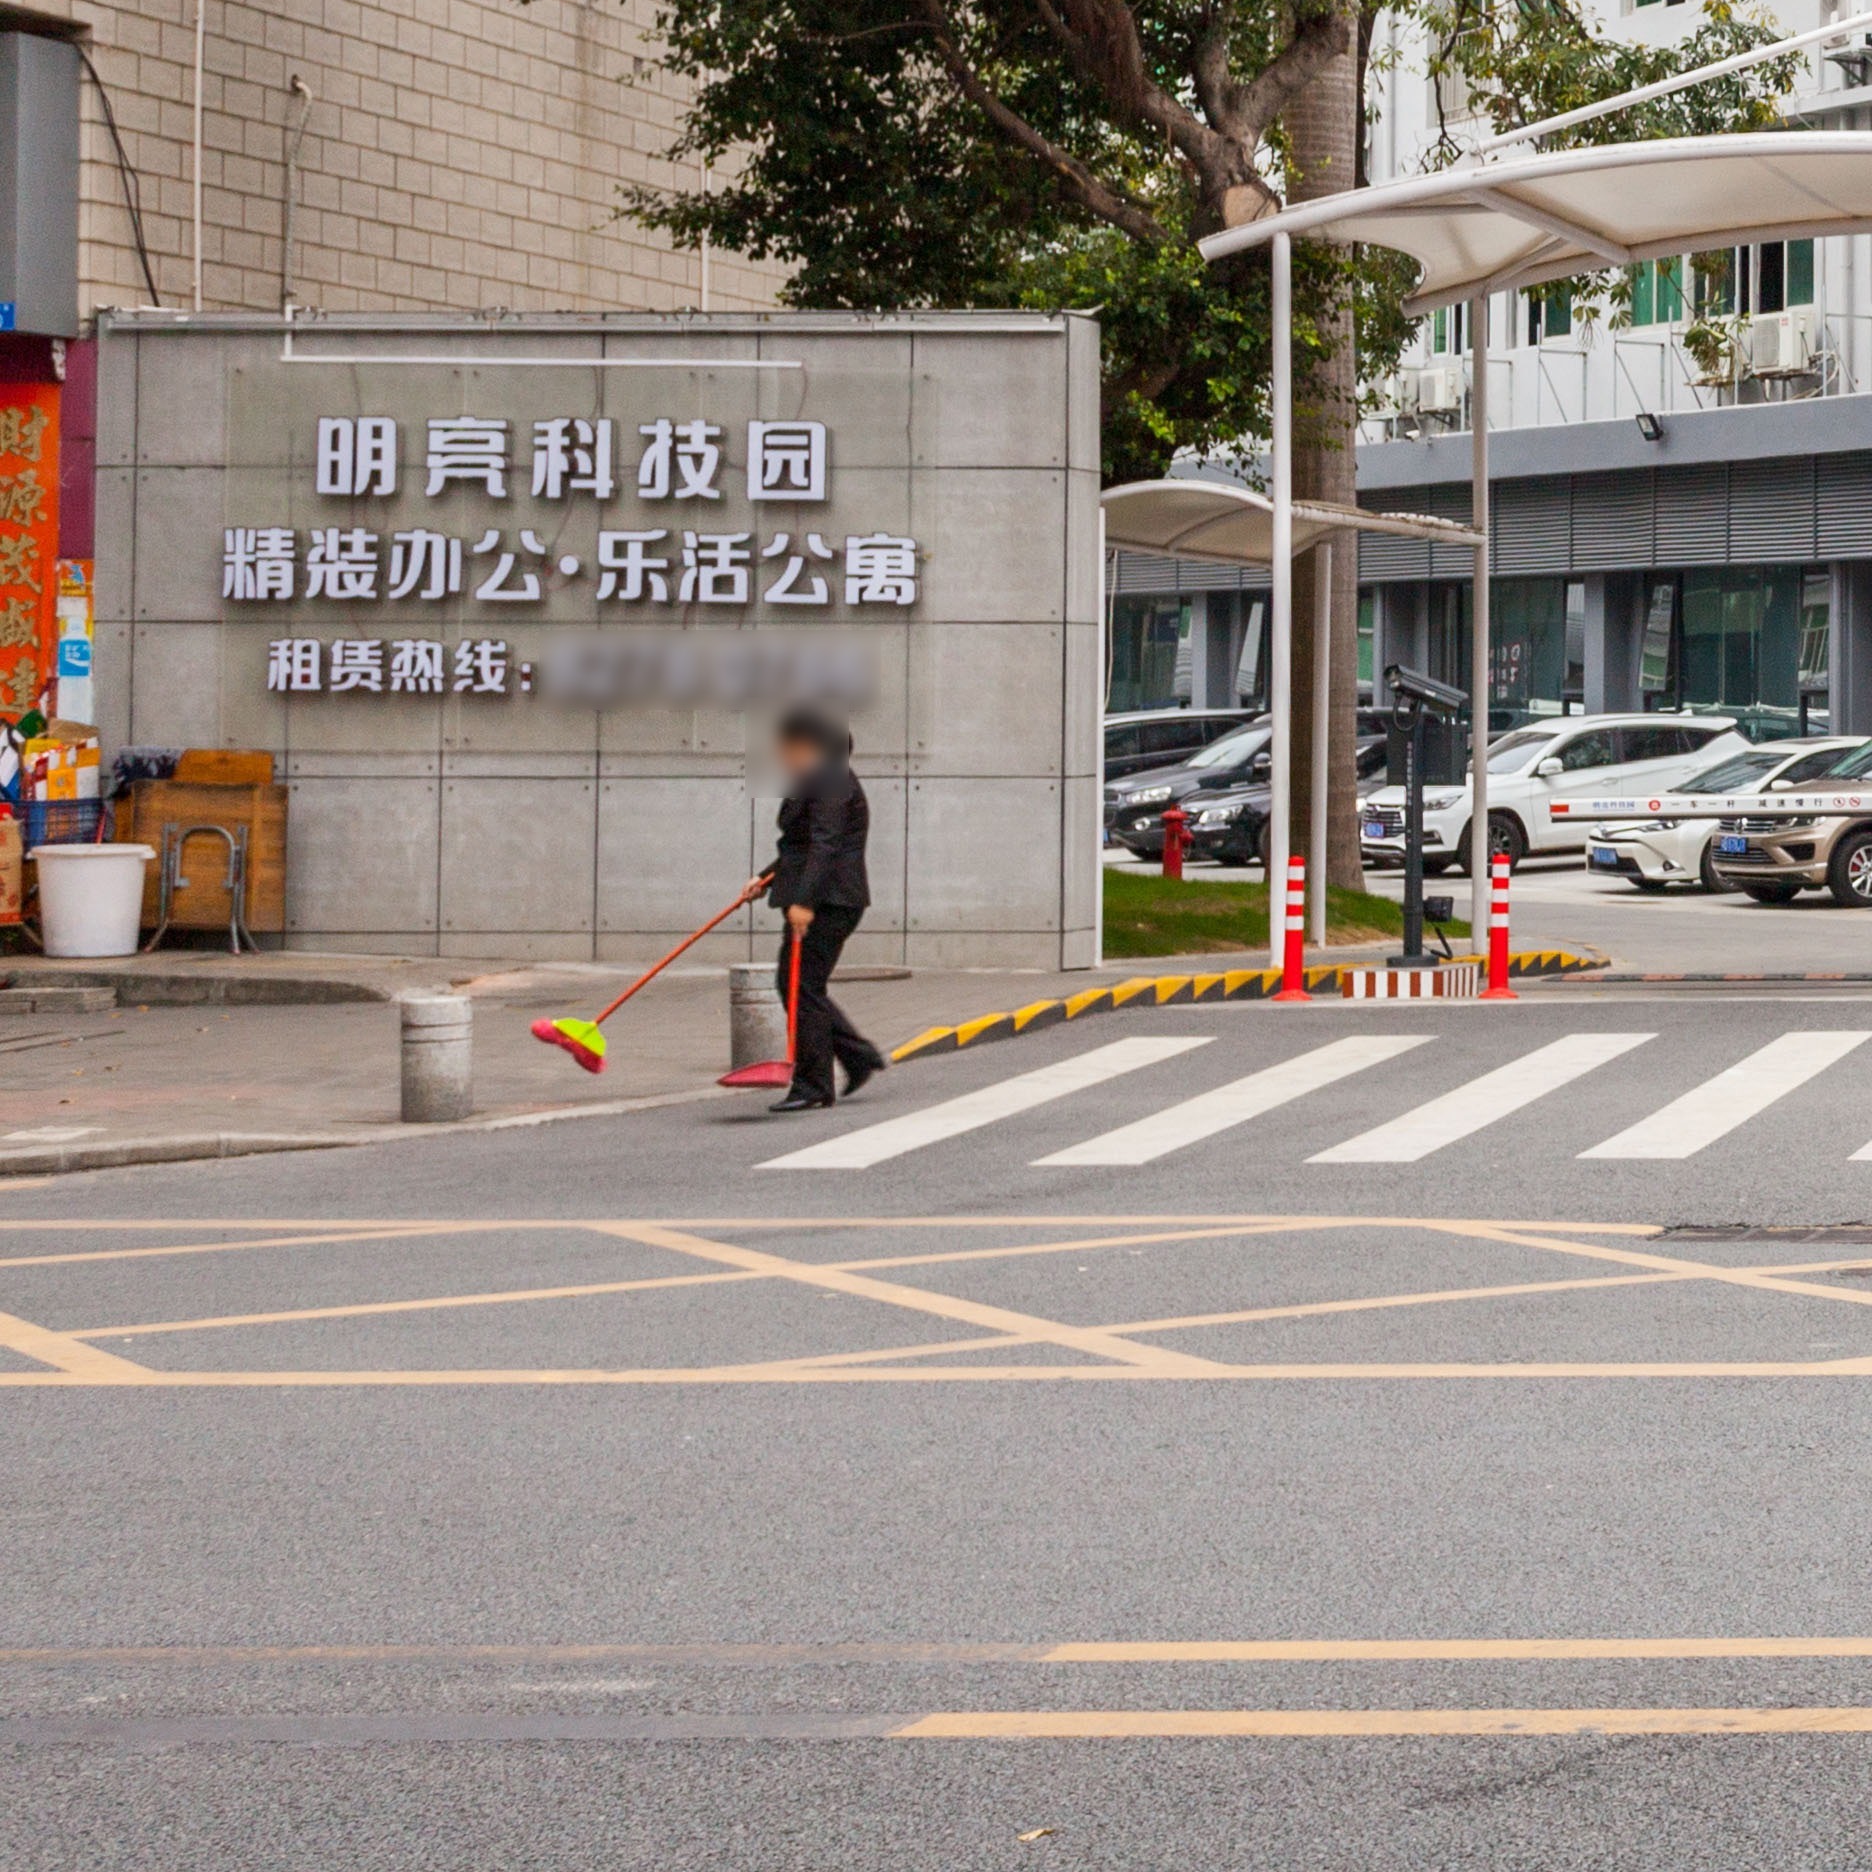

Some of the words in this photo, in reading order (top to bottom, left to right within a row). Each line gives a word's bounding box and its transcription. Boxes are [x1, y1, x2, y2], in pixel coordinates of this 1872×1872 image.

[316, 416, 828, 502] 明亮科技园
